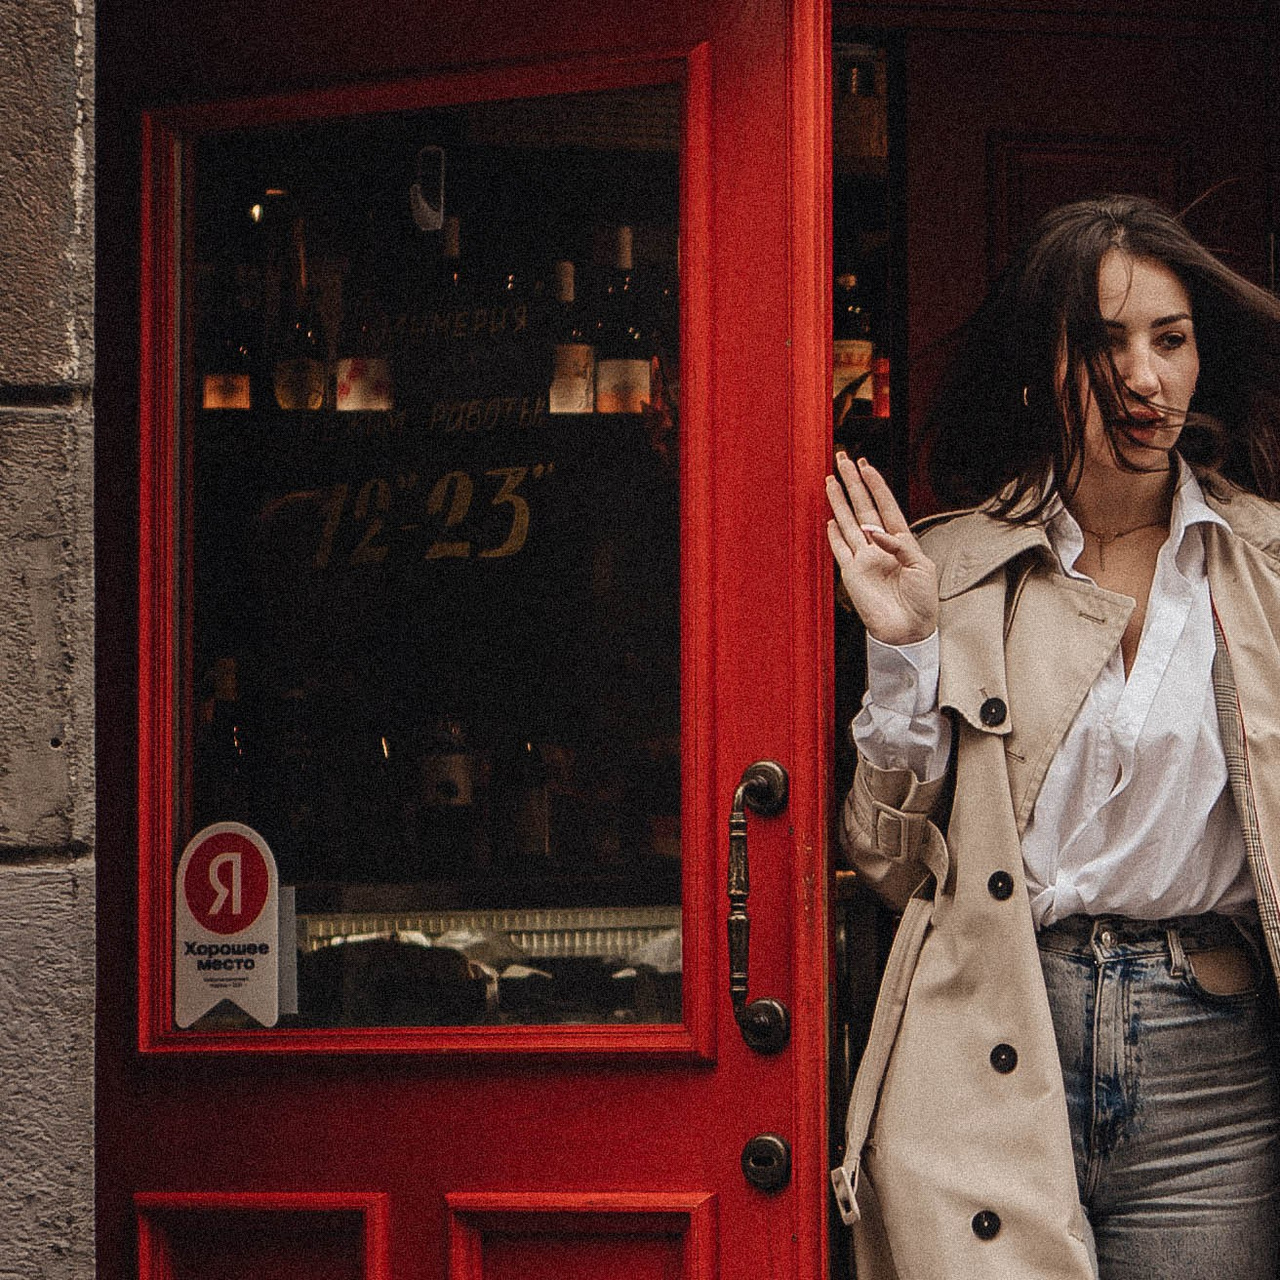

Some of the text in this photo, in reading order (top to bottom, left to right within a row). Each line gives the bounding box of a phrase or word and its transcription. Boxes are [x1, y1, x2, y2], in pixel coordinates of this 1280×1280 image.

[209, 853, 242, 915] Я
[183, 941, 270, 958] Хорошее
[197, 958, 256, 971] место
